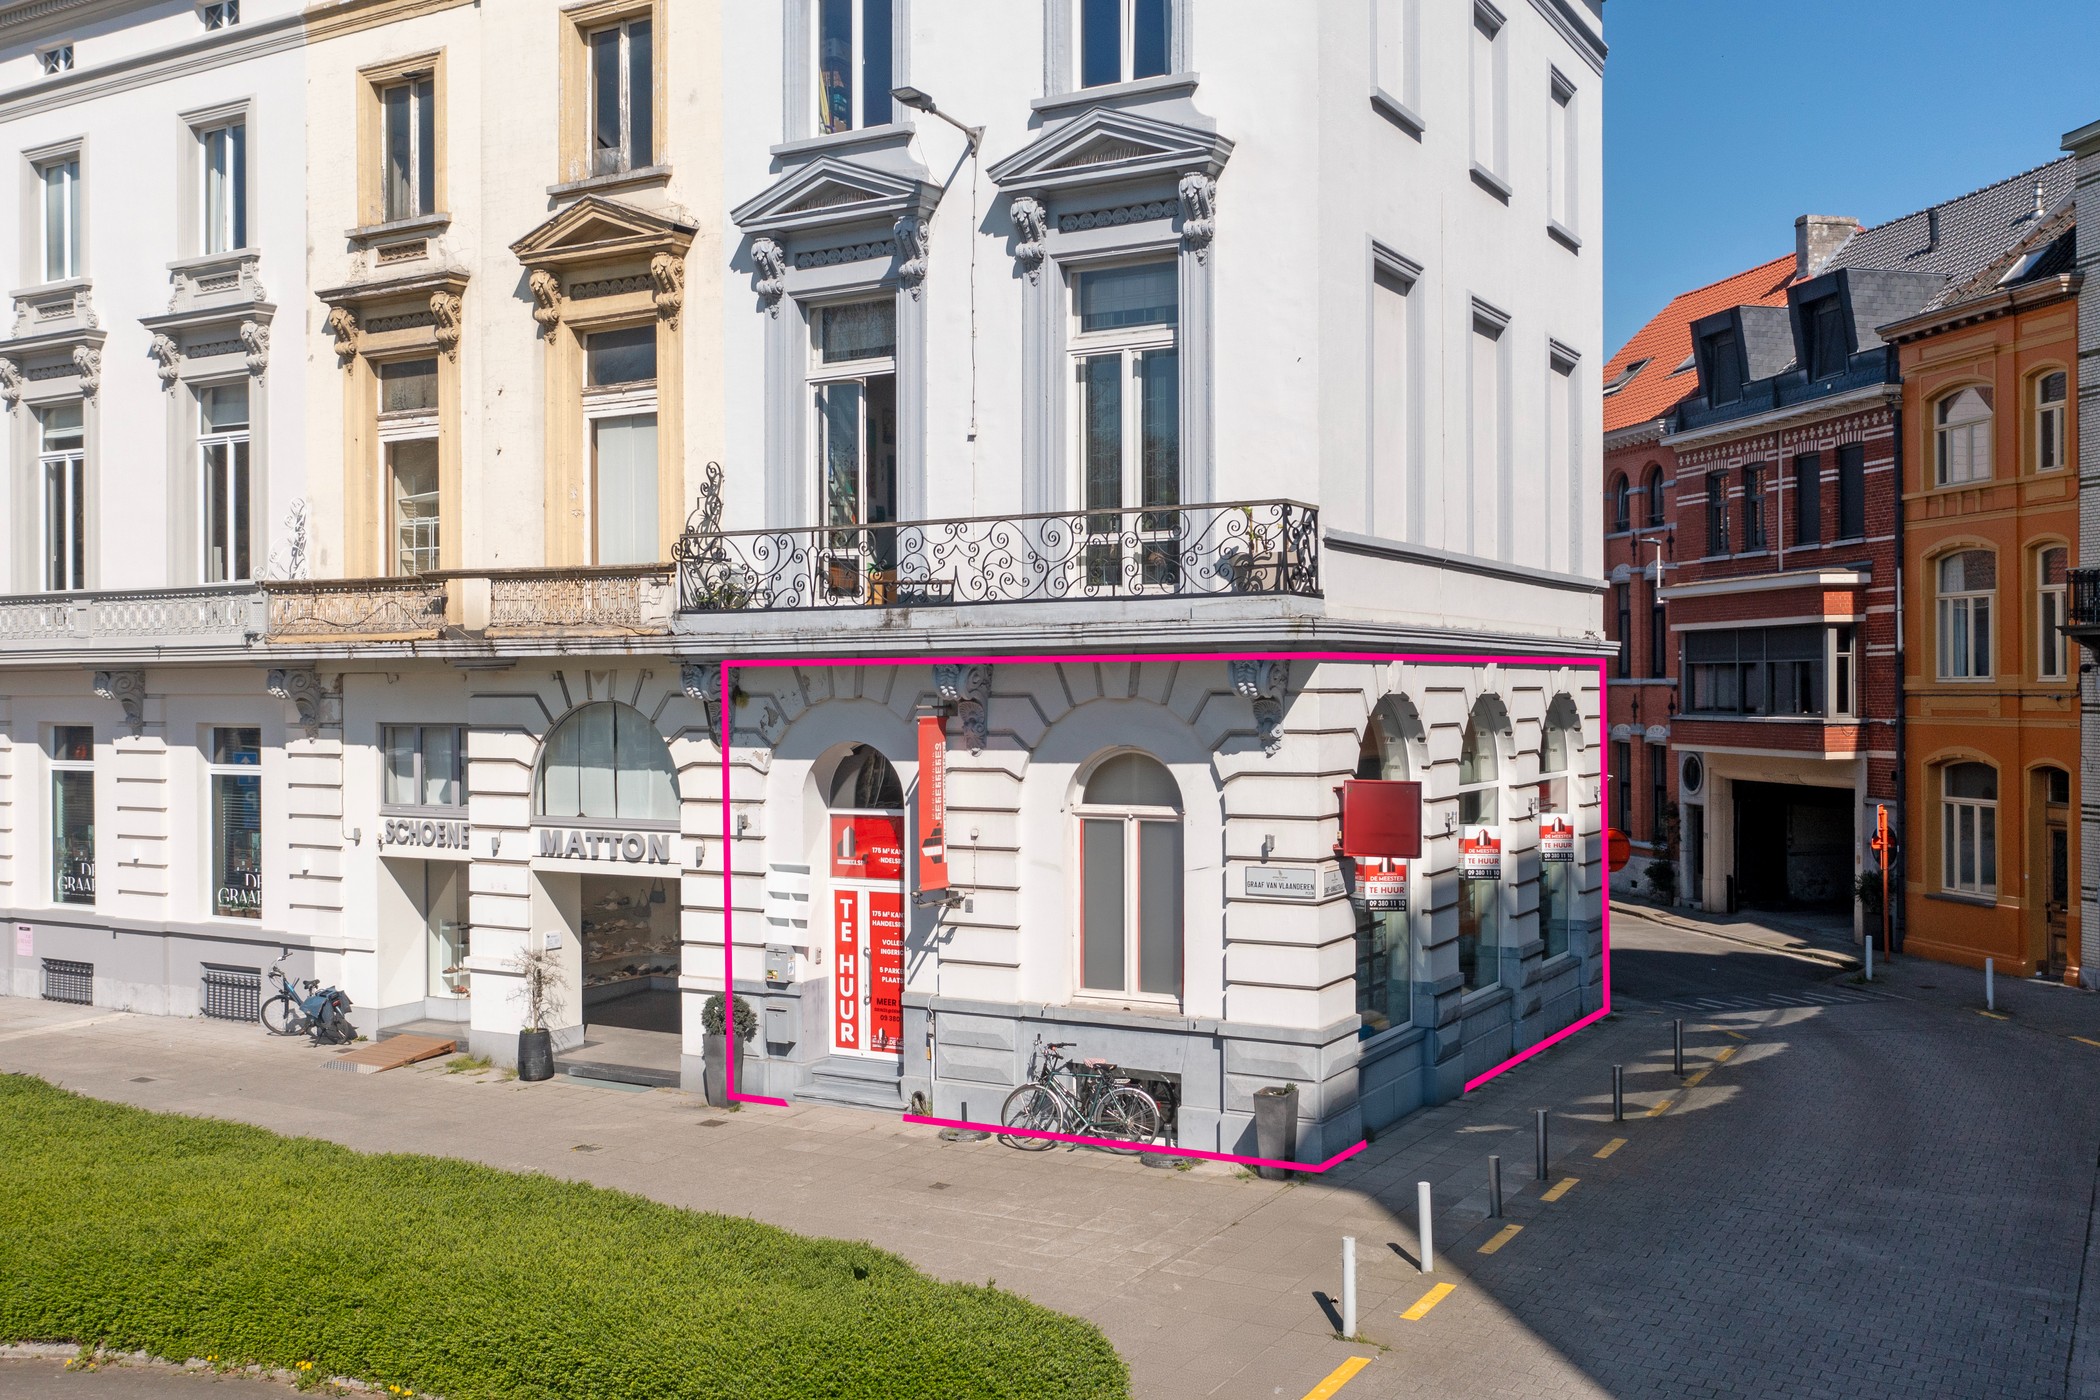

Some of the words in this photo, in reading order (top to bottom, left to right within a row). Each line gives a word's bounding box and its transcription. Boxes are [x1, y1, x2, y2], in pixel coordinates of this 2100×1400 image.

[385, 819, 470, 850] SCHOENE
[540, 829, 671, 865] MATTON
[1468, 857, 1476, 865] TE
[1477, 857, 1499, 865] HUUR
[1247, 880, 1264, 888] GRAAF
[1266, 881, 1277, 889] VAN
[1279, 882, 1315, 891] VLAANDEREN
[839, 898, 853, 943] TE
[839, 953, 855, 1043] HUUR
[876, 998, 897, 1006] MEER
